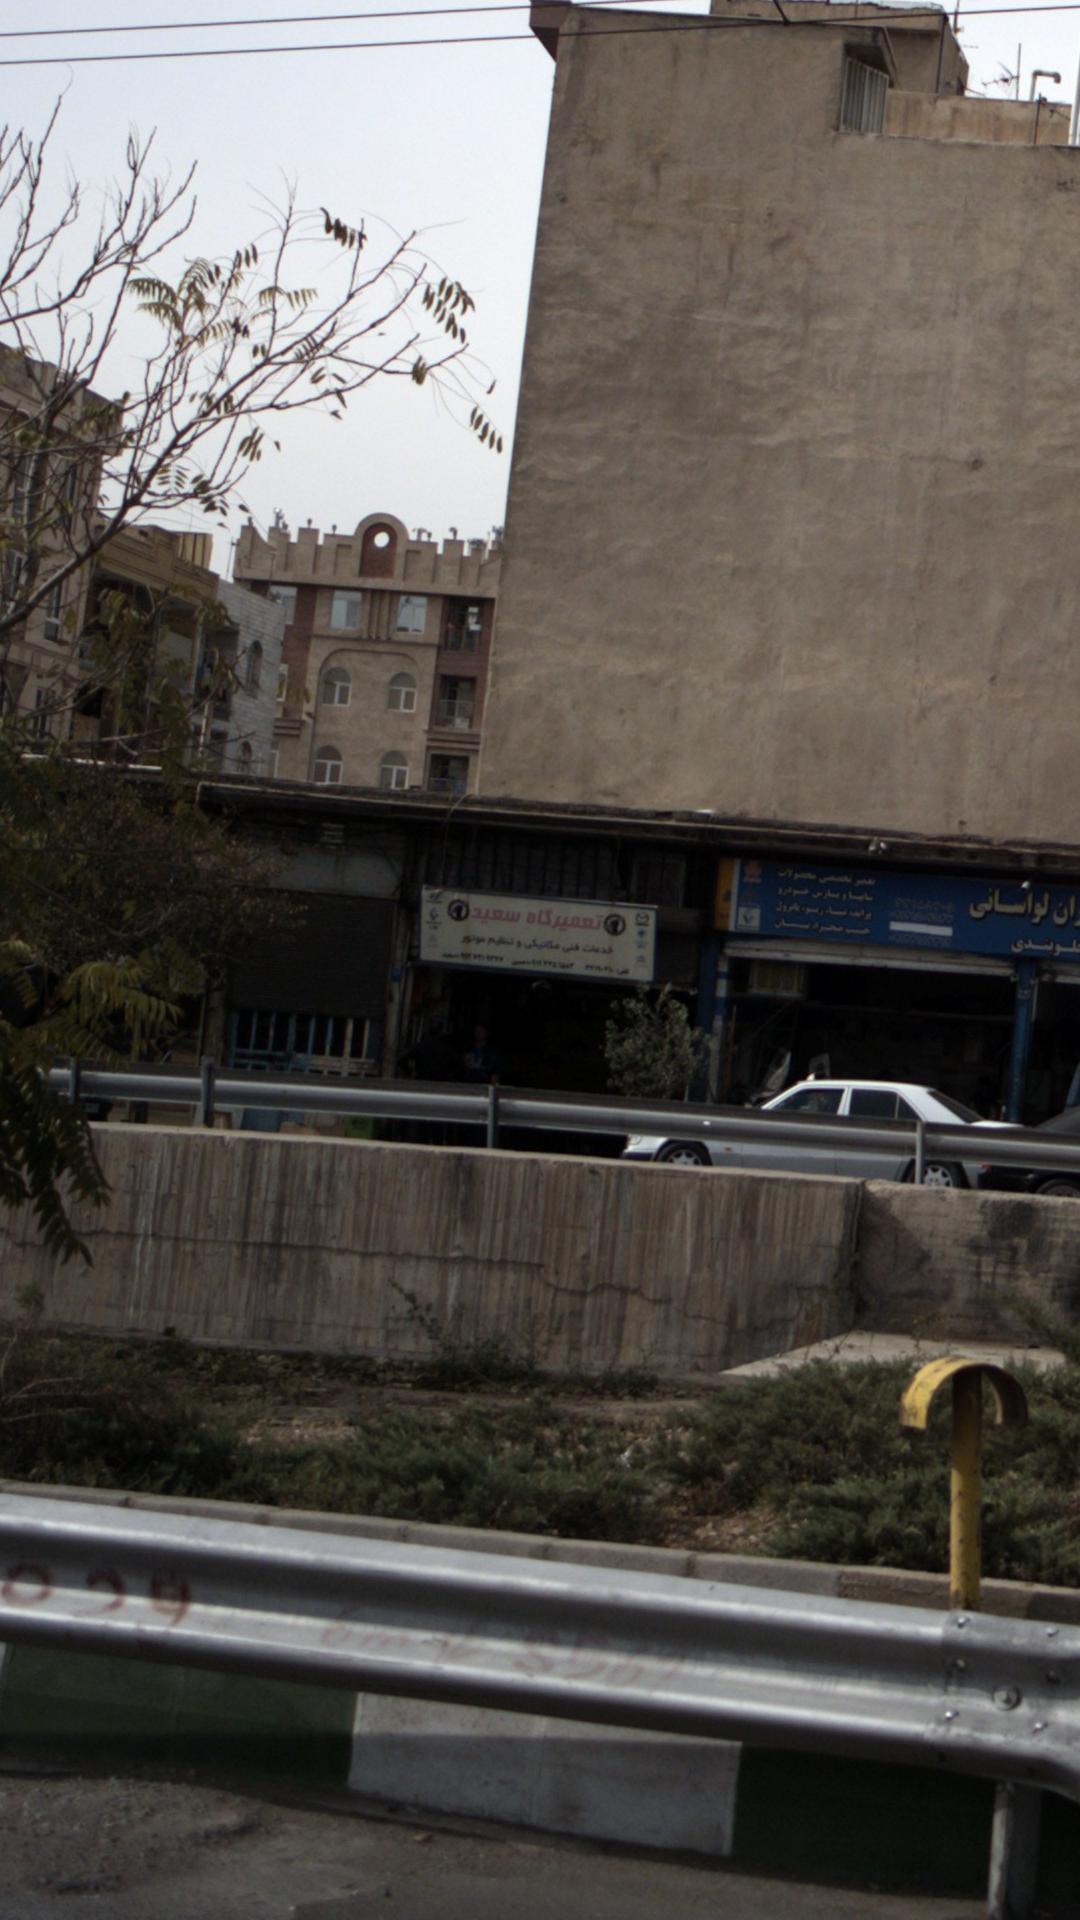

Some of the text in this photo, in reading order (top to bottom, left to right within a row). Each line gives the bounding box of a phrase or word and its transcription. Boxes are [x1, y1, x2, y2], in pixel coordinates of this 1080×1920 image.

[969, 888, 1050, 925] لواسانی
[471, 907, 604, 931] تعمیرگاه سعید
[524, 938, 560, 950] مکانیکی
[561, 943, 580, 953] فنی
[582, 943, 613, 954] خدمات
